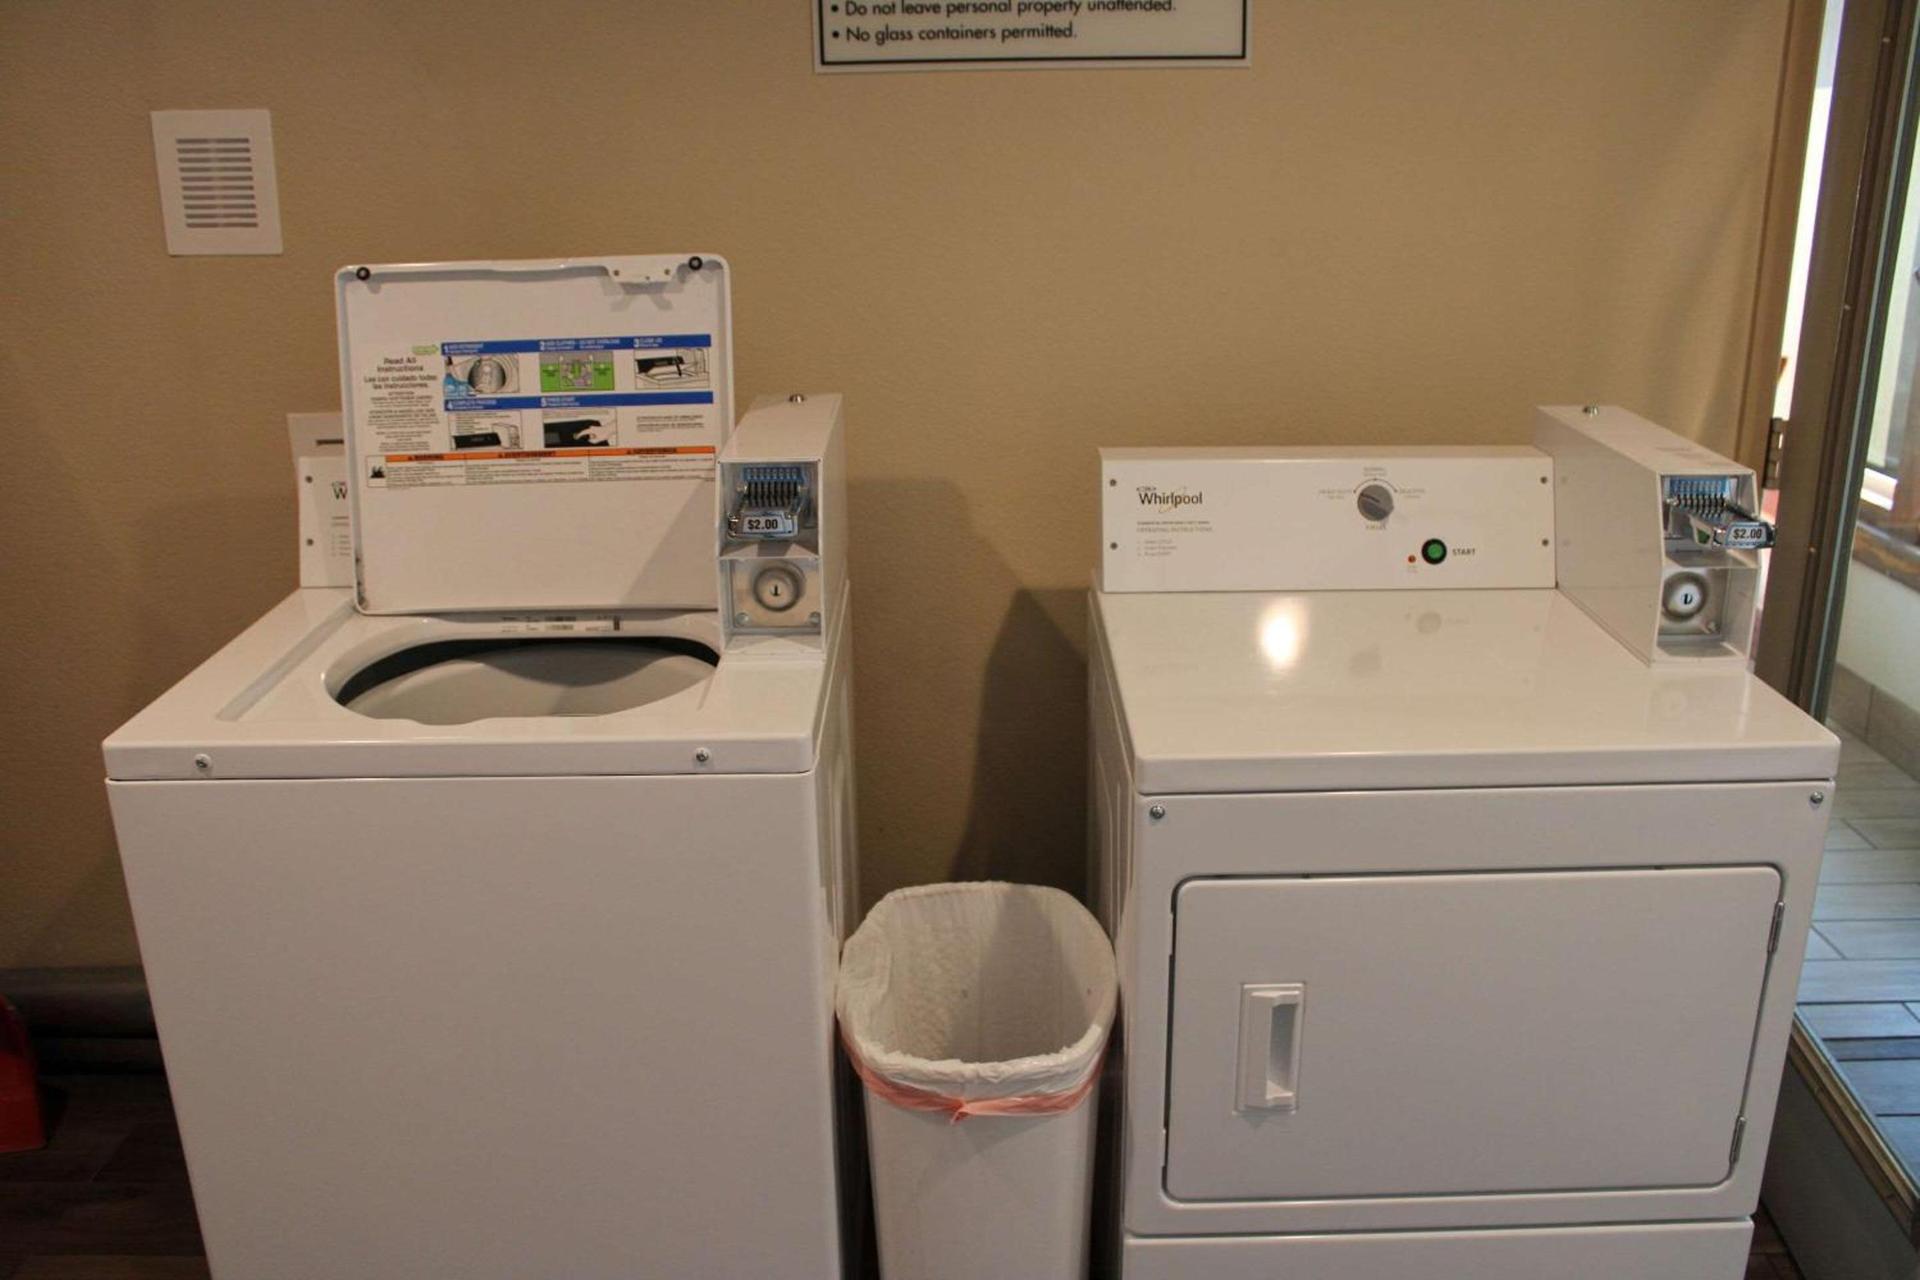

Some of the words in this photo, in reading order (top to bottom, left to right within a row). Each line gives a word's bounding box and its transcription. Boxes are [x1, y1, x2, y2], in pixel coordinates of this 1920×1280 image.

[845, 1, 868, 16] Do
[872, 1, 896, 15] not
[902, 0, 942, 15] leave
[947, 0, 1012, 18] personal
[1017, 0, 1082, 16] property
[846, 27, 871, 42] No
[875, 24, 914, 46] glass
[918, 24, 996, 41] containers
[1001, 21, 1078, 43] permitted.
[1138, 491, 1203, 508] Whirlpool
[747, 518, 779, 530] $2.00
[1732, 528, 1762, 540] $2.00
[1452, 548, 1476, 556] START
